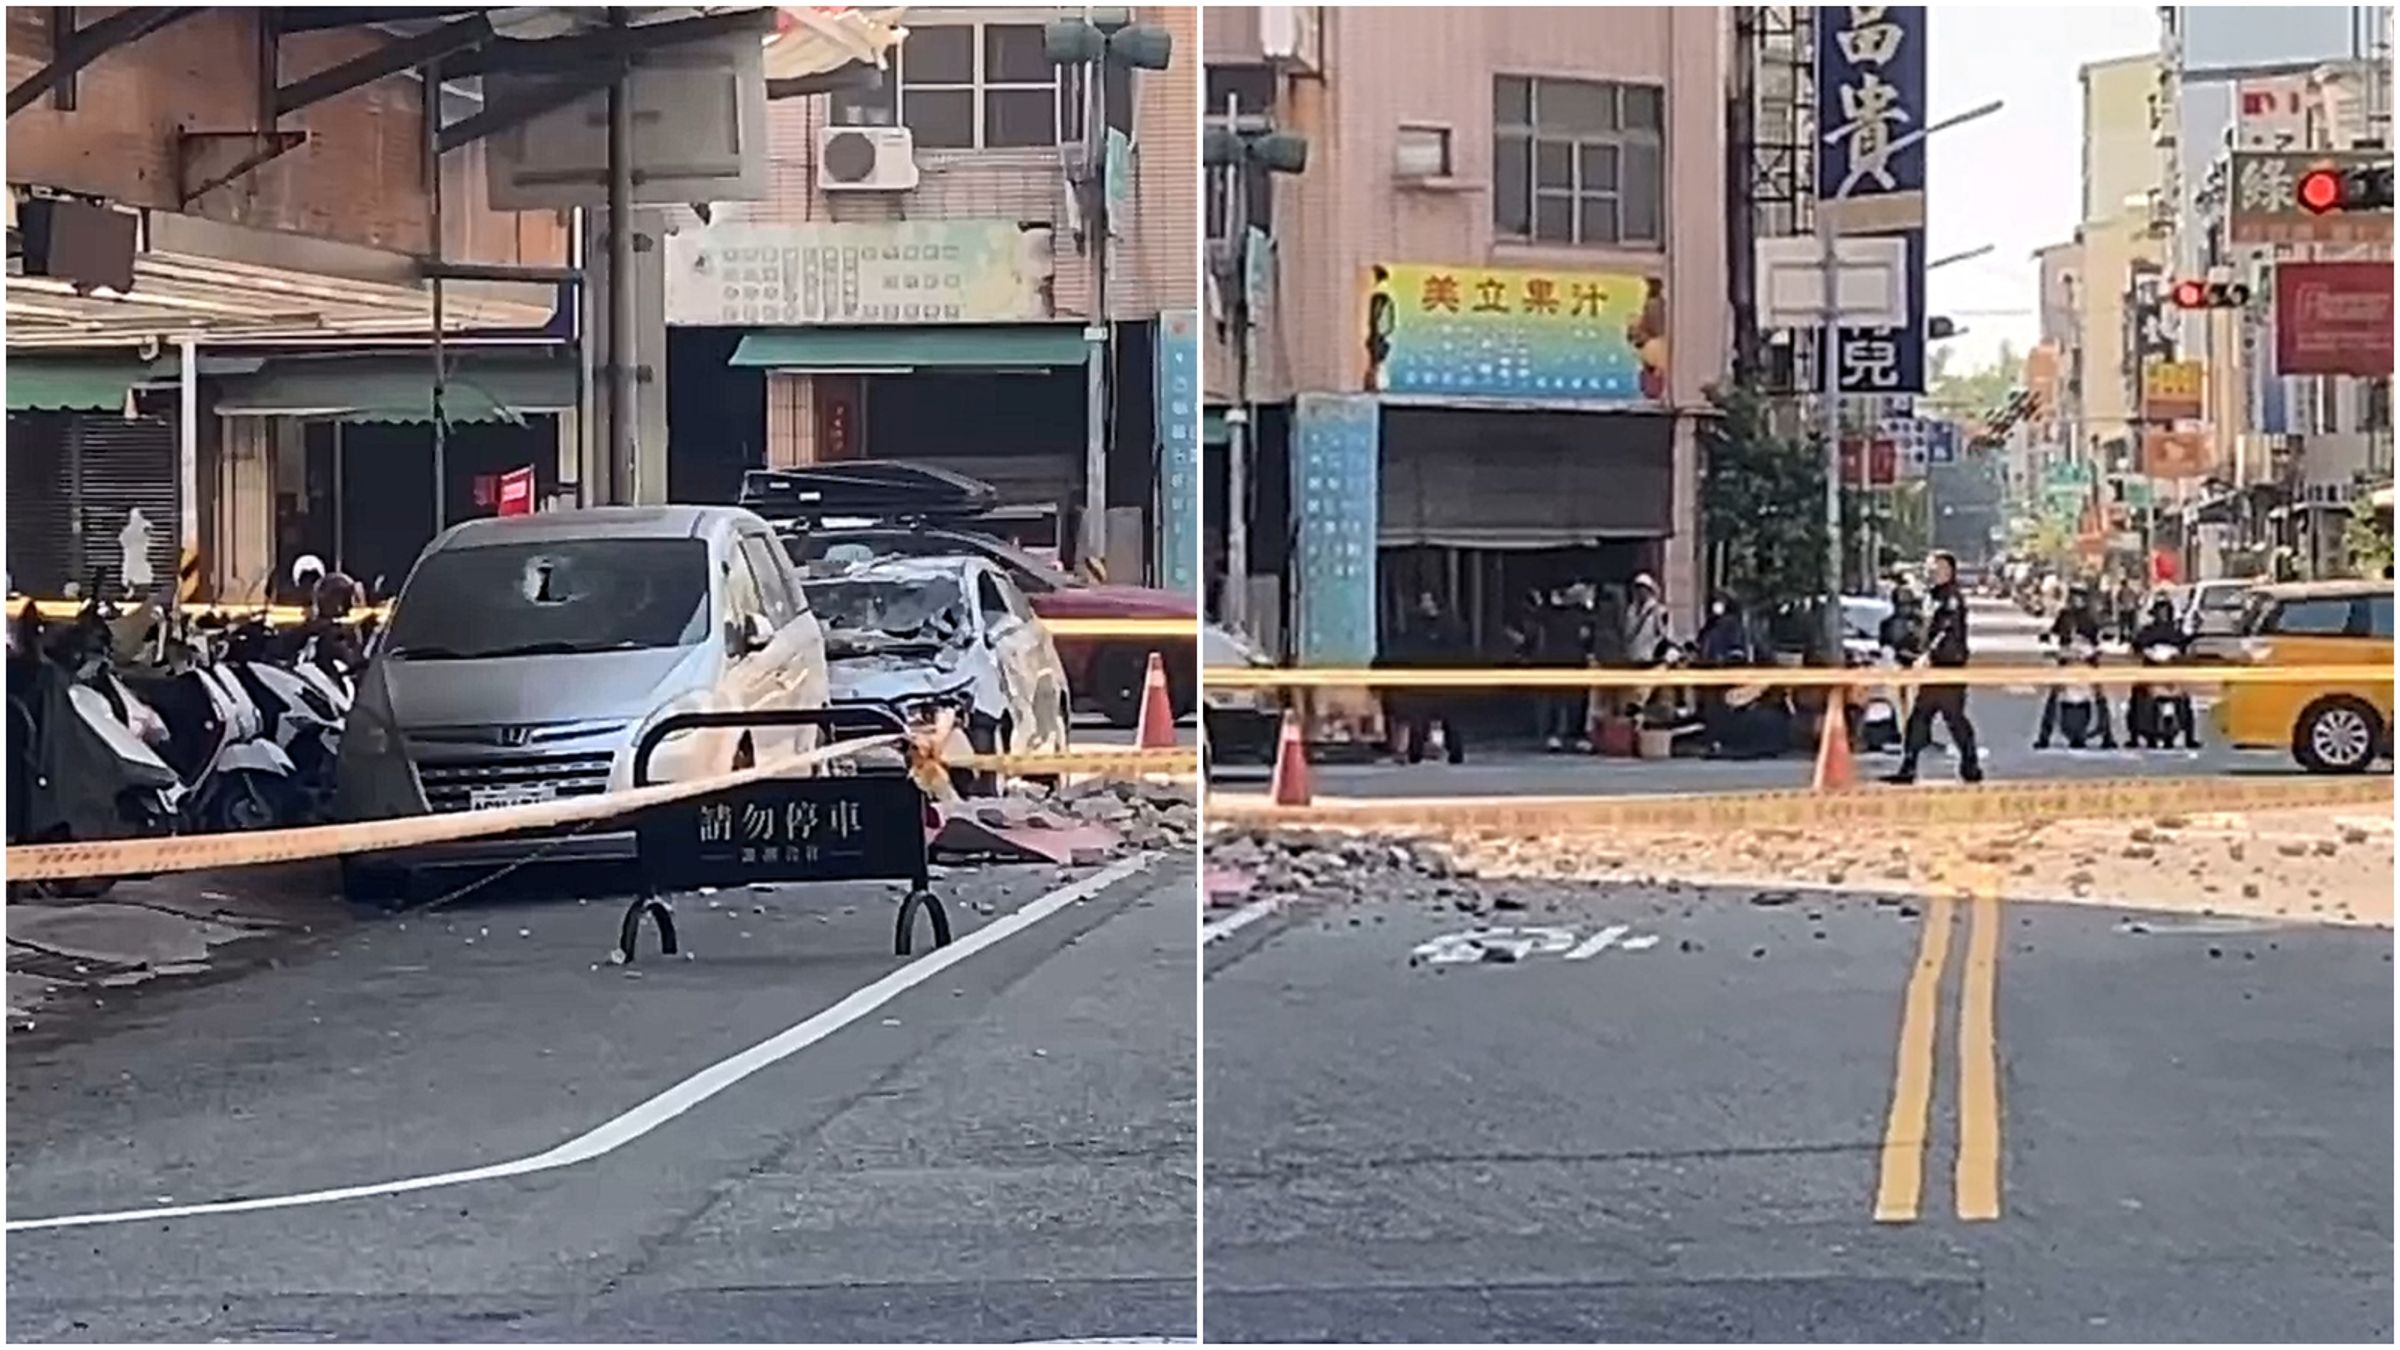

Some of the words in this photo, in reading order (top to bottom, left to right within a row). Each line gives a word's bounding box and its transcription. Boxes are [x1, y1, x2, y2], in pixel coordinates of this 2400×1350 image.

[1421, 274, 1609, 317] 美立果汁
[1841, 327, 1899, 386] 兒
[700, 800, 862, 841] 請勿停車
